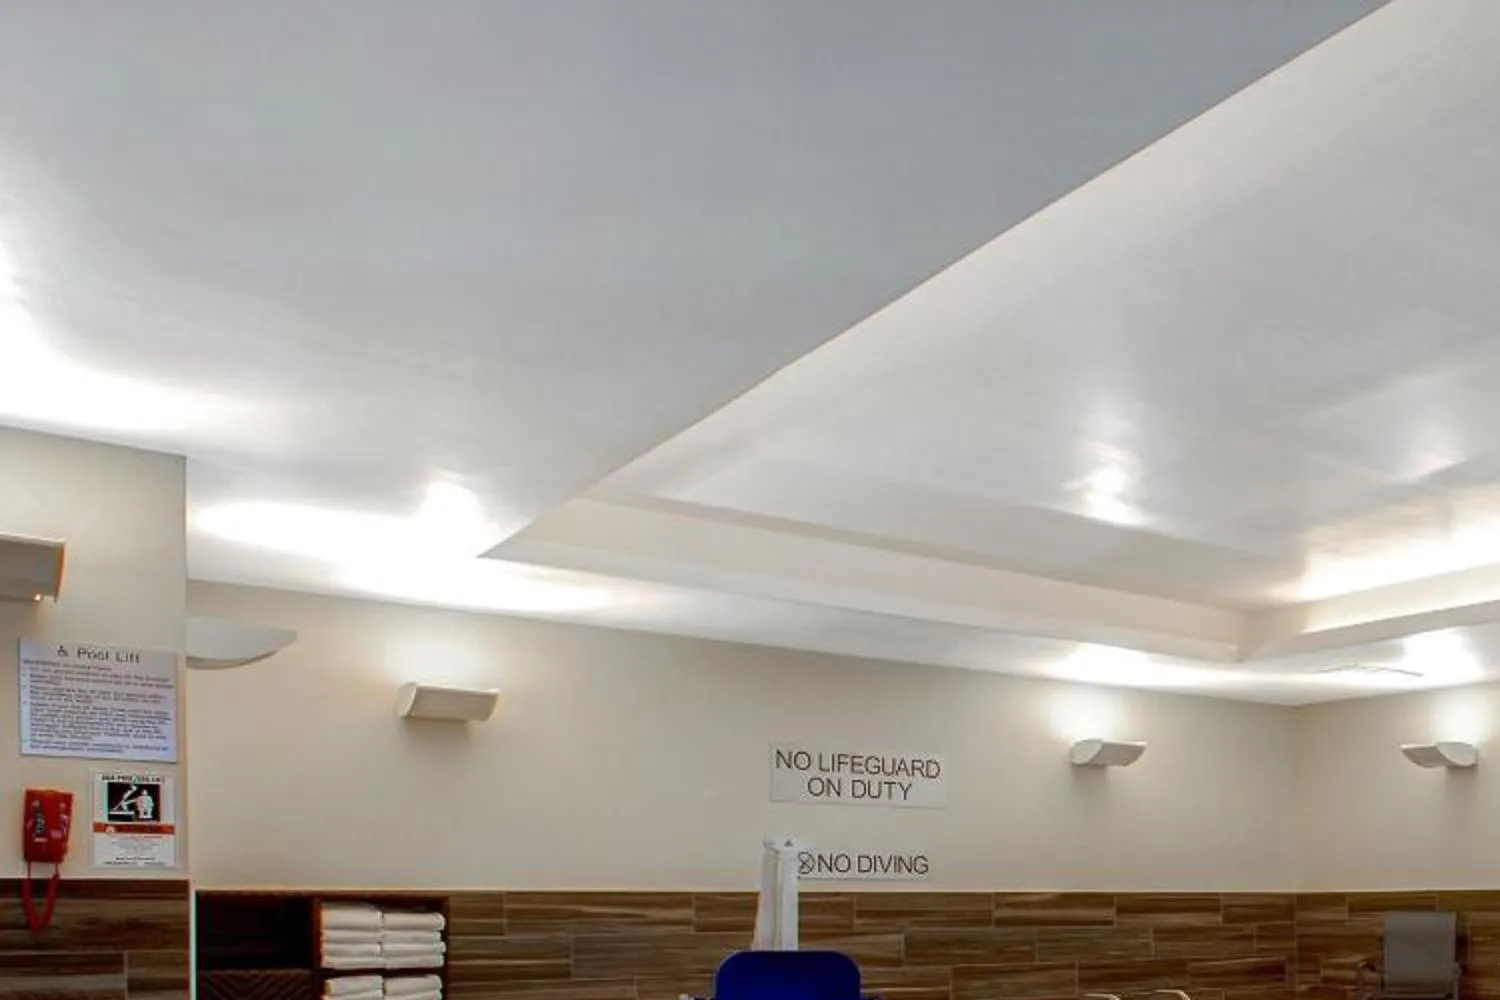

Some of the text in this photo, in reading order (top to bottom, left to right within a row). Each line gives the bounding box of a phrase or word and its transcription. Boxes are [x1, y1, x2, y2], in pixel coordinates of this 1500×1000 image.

[77, 647, 110, 662] Pool
[775, 749, 941, 779] NO LIFEGUARD
[807, 777, 913, 800] ON DUTY
[817, 853, 930, 874] NO DIVING
